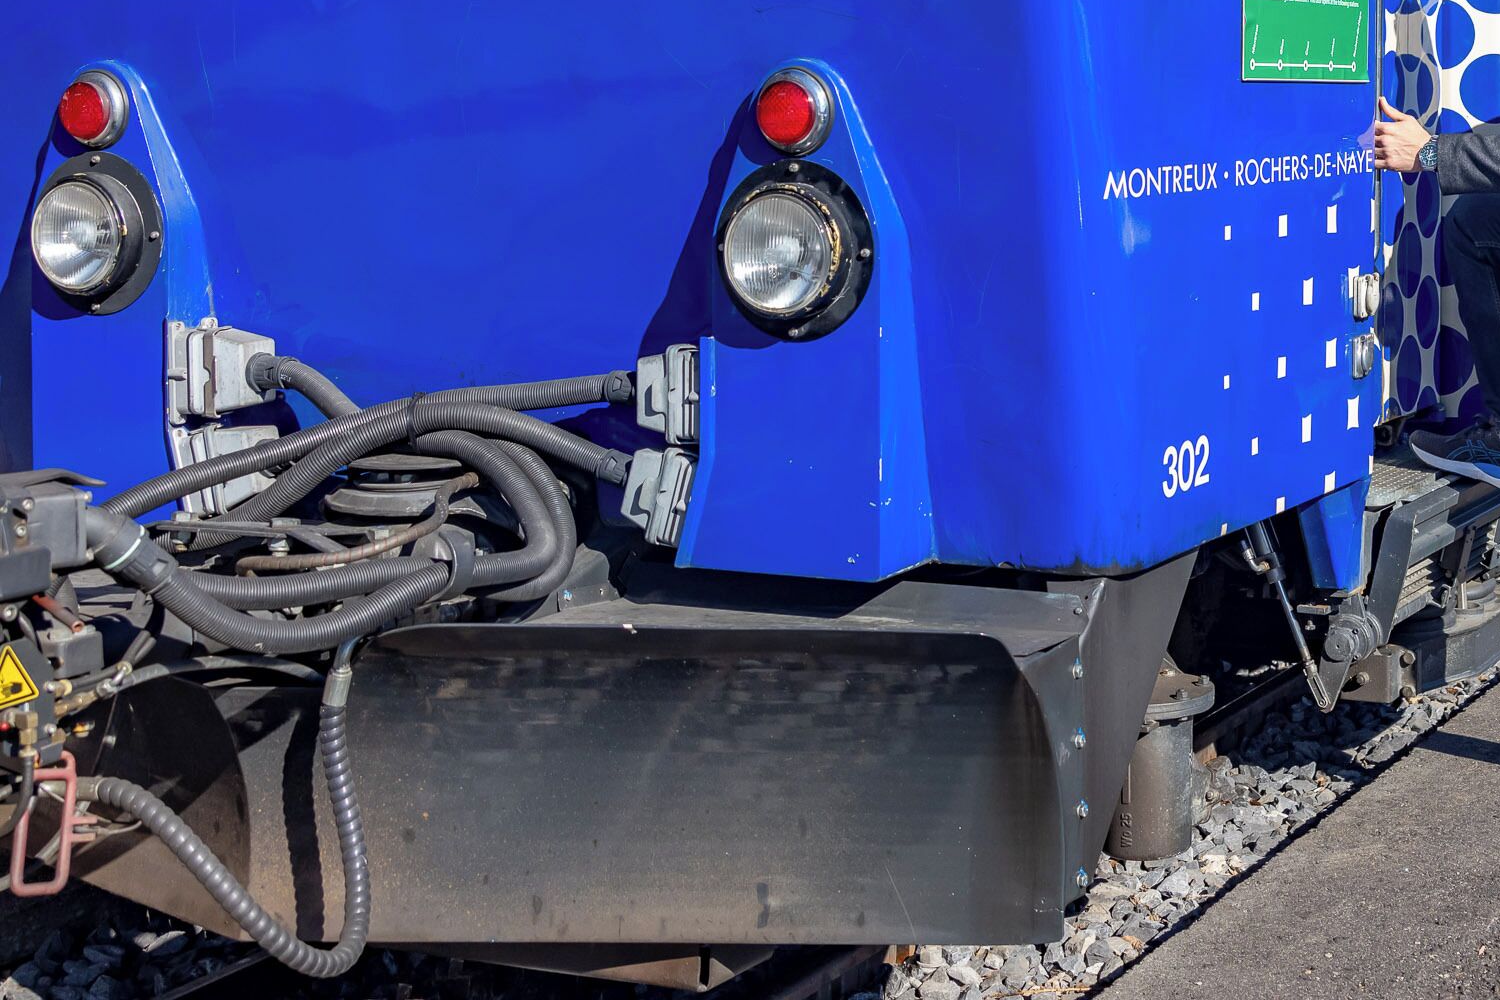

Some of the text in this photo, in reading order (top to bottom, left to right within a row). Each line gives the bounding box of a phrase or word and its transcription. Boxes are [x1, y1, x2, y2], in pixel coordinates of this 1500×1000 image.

[1103, 149, 1373, 200] MONTREUX ROCHERS-DE-NAYE
[1162, 434, 1210, 499] 302
